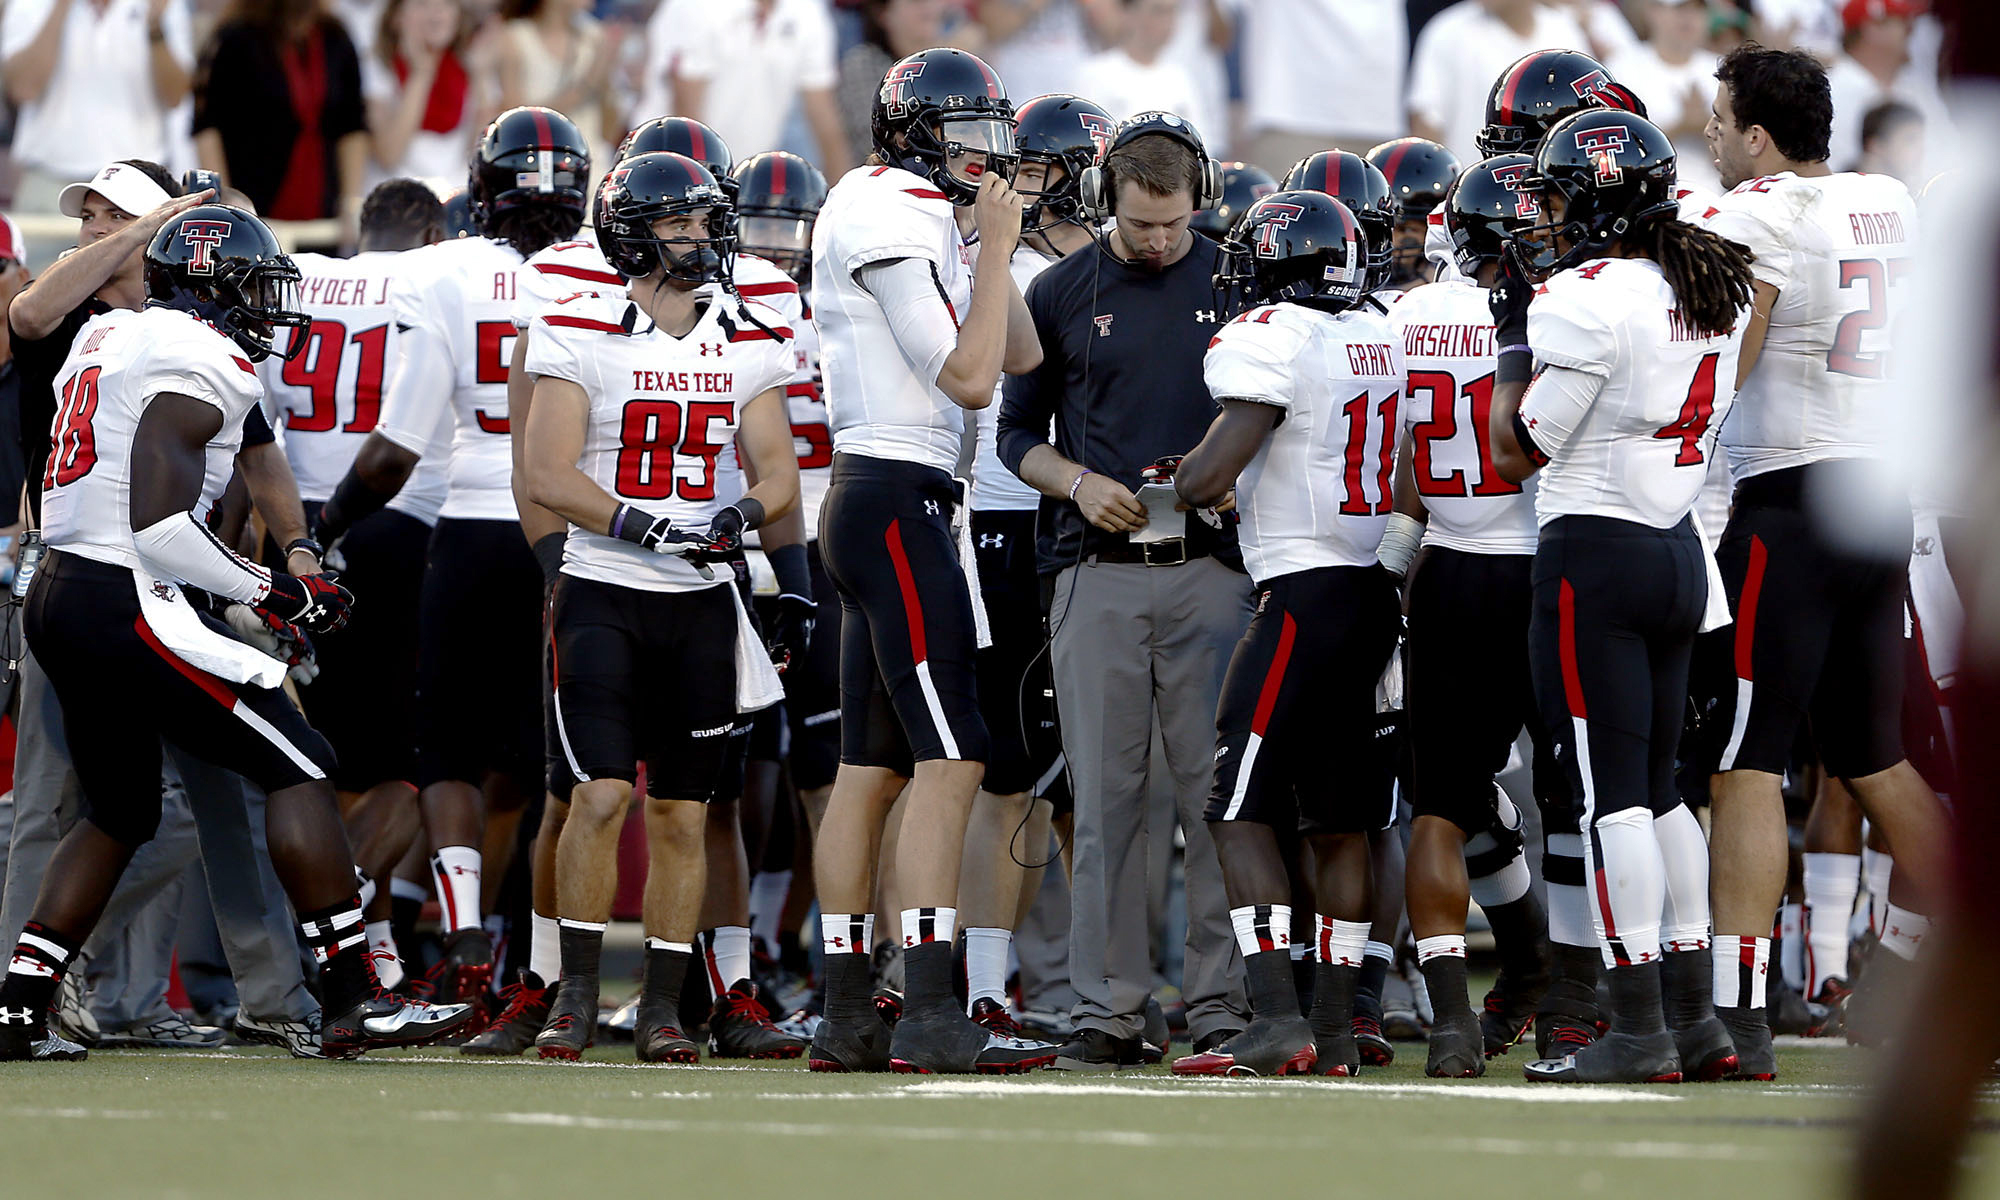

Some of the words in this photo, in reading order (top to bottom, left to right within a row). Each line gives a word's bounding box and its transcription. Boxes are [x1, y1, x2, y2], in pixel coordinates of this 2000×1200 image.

[281, 319, 390, 433] 91
[632, 370, 688, 392] TEXAS
[693, 372, 733, 393] TECH
[1346, 344, 1396, 376] GRANT
[1653, 352, 1720, 467] 4
[43, 366, 102, 491] 18
[615, 399, 735, 501] 85
[1339, 388, 1400, 517] 11
[1405, 369, 1523, 497] 21
